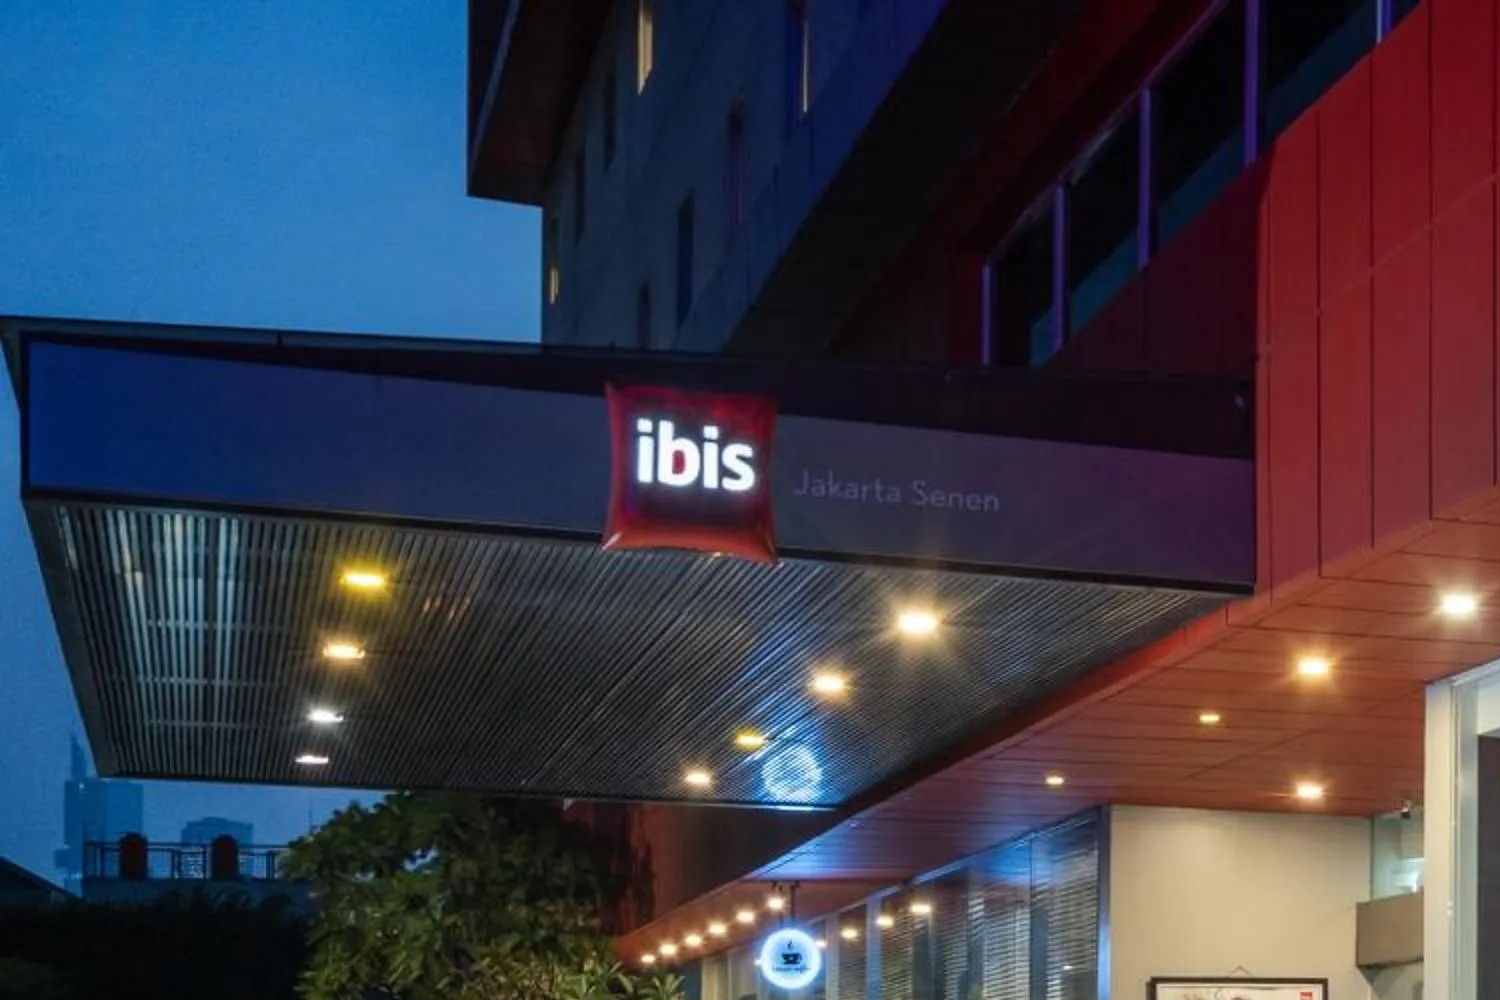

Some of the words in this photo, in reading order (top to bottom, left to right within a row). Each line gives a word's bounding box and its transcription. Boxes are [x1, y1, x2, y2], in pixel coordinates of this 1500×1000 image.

[636, 417, 756, 492] ibis
[794, 467, 901, 504] Jakarta
[911, 477, 1000, 512] Senen
